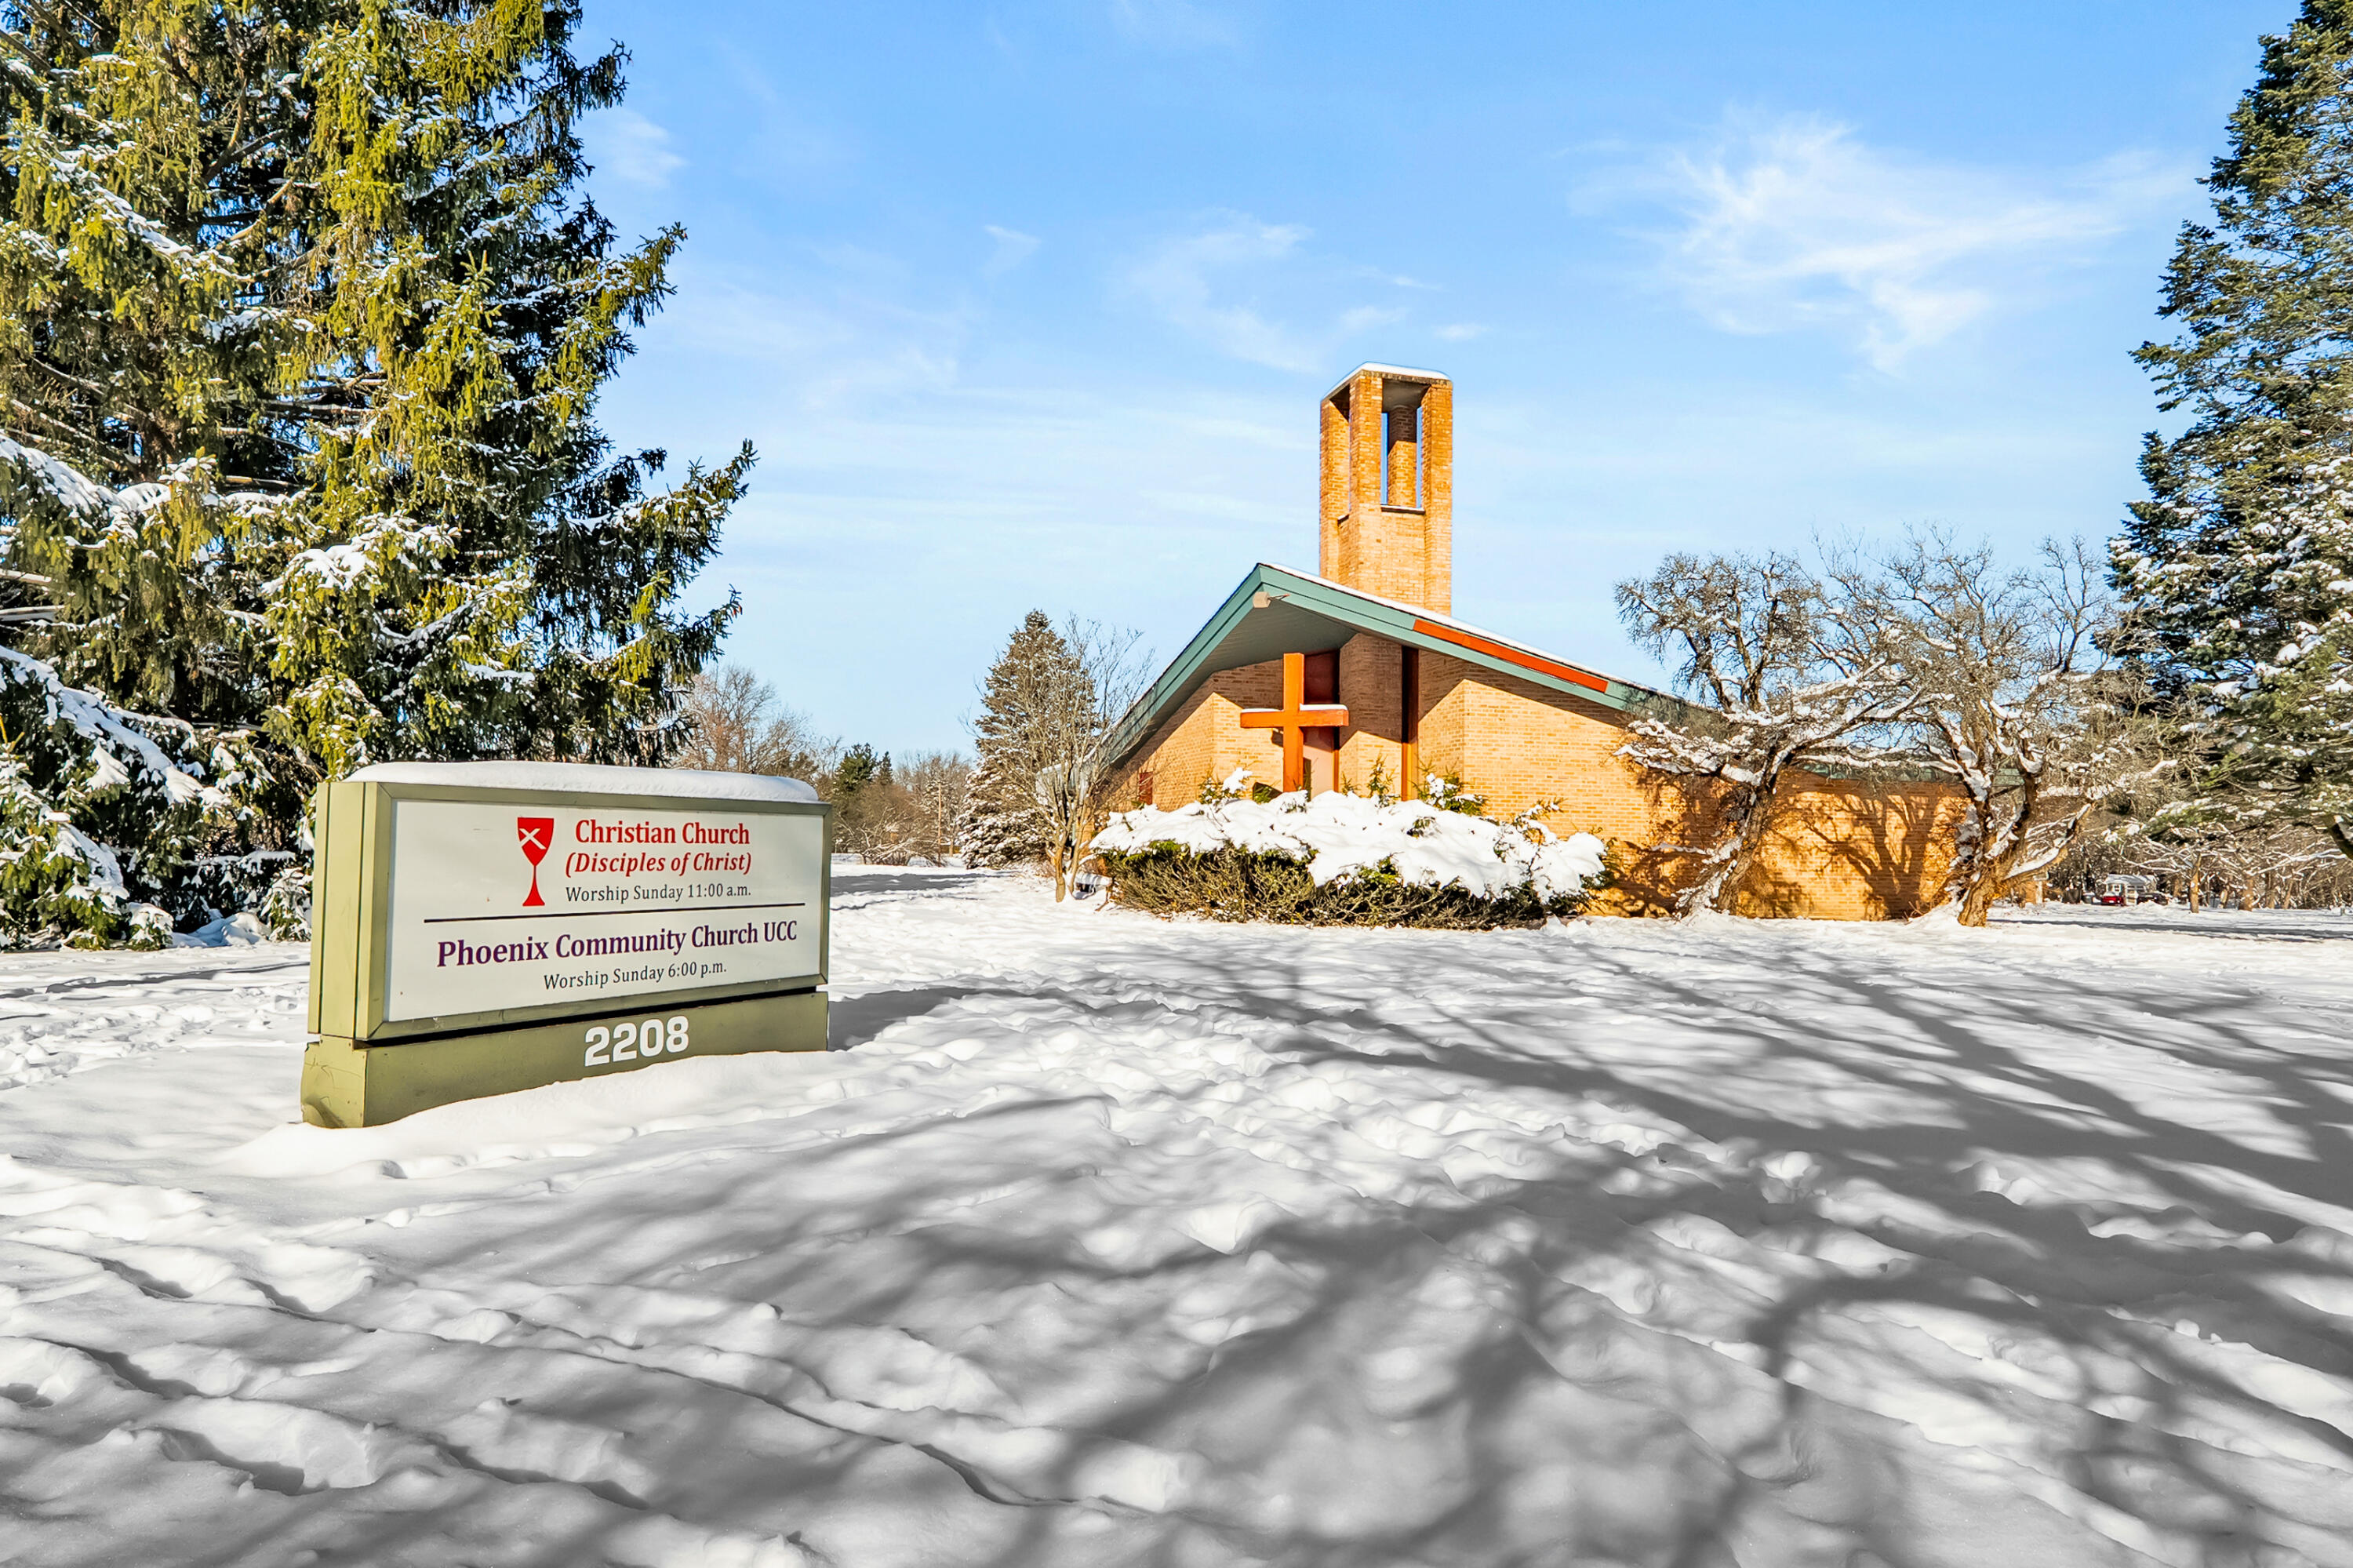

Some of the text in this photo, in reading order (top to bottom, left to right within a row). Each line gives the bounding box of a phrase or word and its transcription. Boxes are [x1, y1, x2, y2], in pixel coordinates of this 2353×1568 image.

[575, 818, 751, 845] Christian Church
[565, 851, 752, 879] (Disciples of Christ)
[565, 882, 751, 904] Worship Sunday 11:00 a.m.
[436, 920, 798, 968] Phoenix Community Church UCC
[543, 961, 727, 991] Worship Sunday 6:00 p.m.
[584, 1015, 689, 1067] 2208
